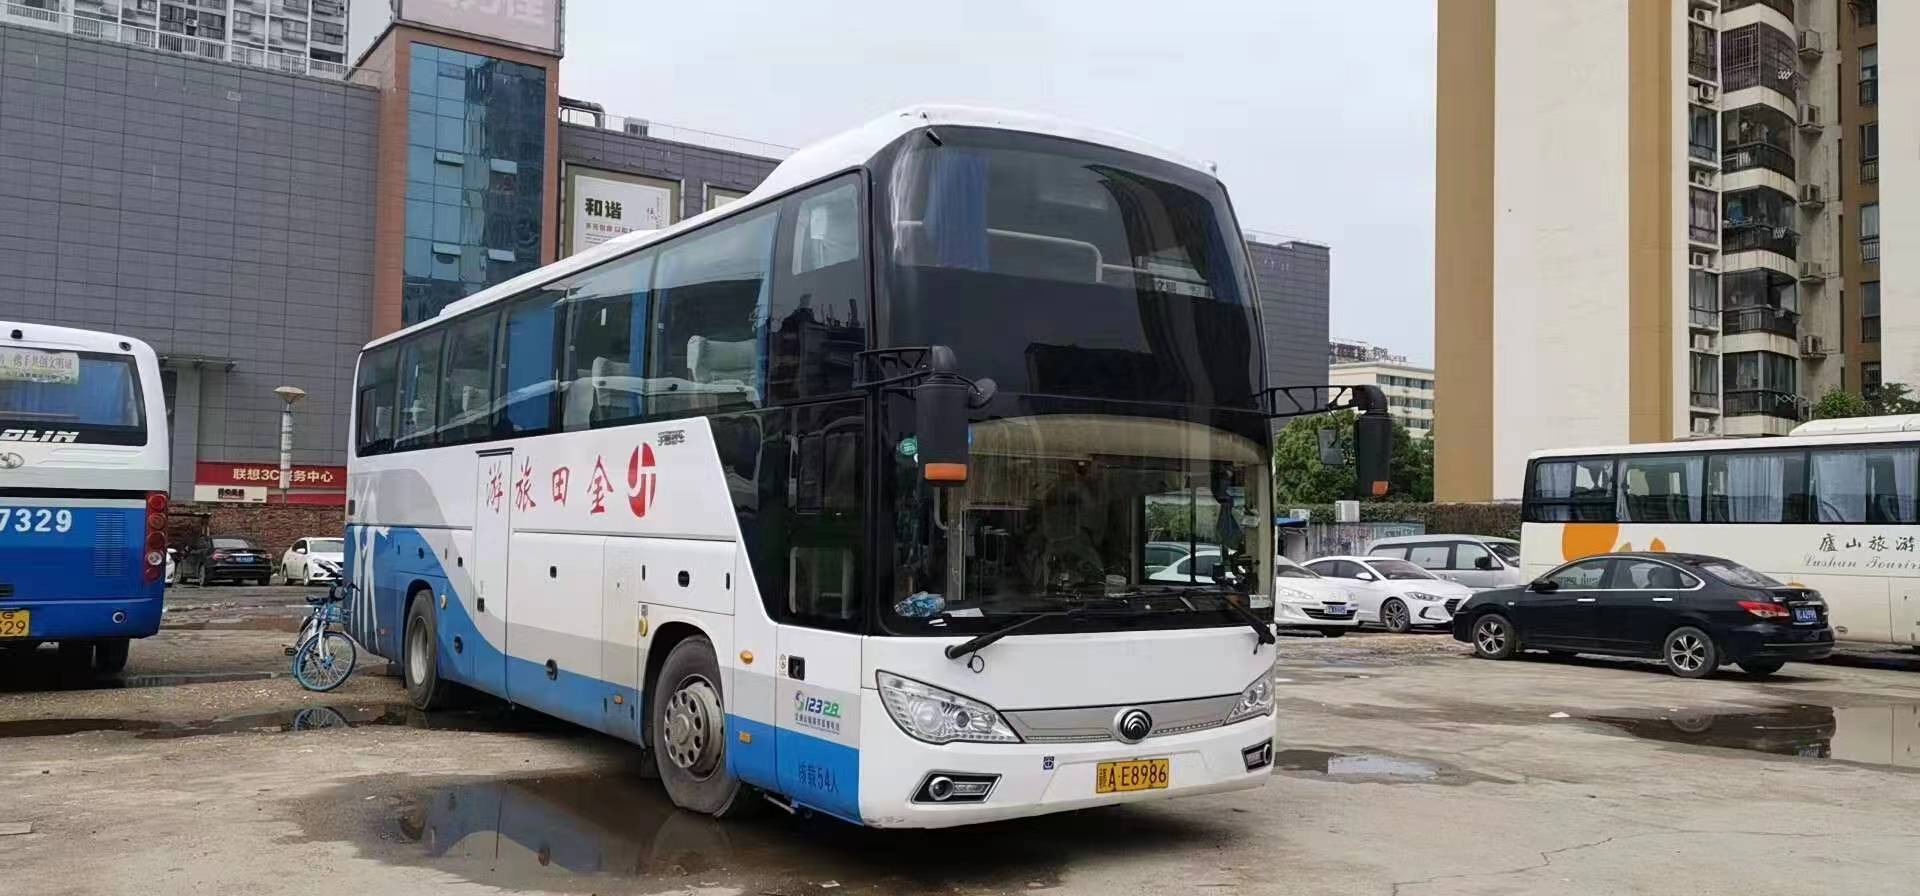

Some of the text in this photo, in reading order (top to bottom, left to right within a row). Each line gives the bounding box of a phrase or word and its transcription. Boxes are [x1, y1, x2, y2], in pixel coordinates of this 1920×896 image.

[585, 198, 622, 220] 和谐
[233, 468, 334, 483] 联想3C务中心
[0, 508, 72, 533] 7329
[0, 620, 26, 635] 29
[805, 697, 841, 719] 12328
